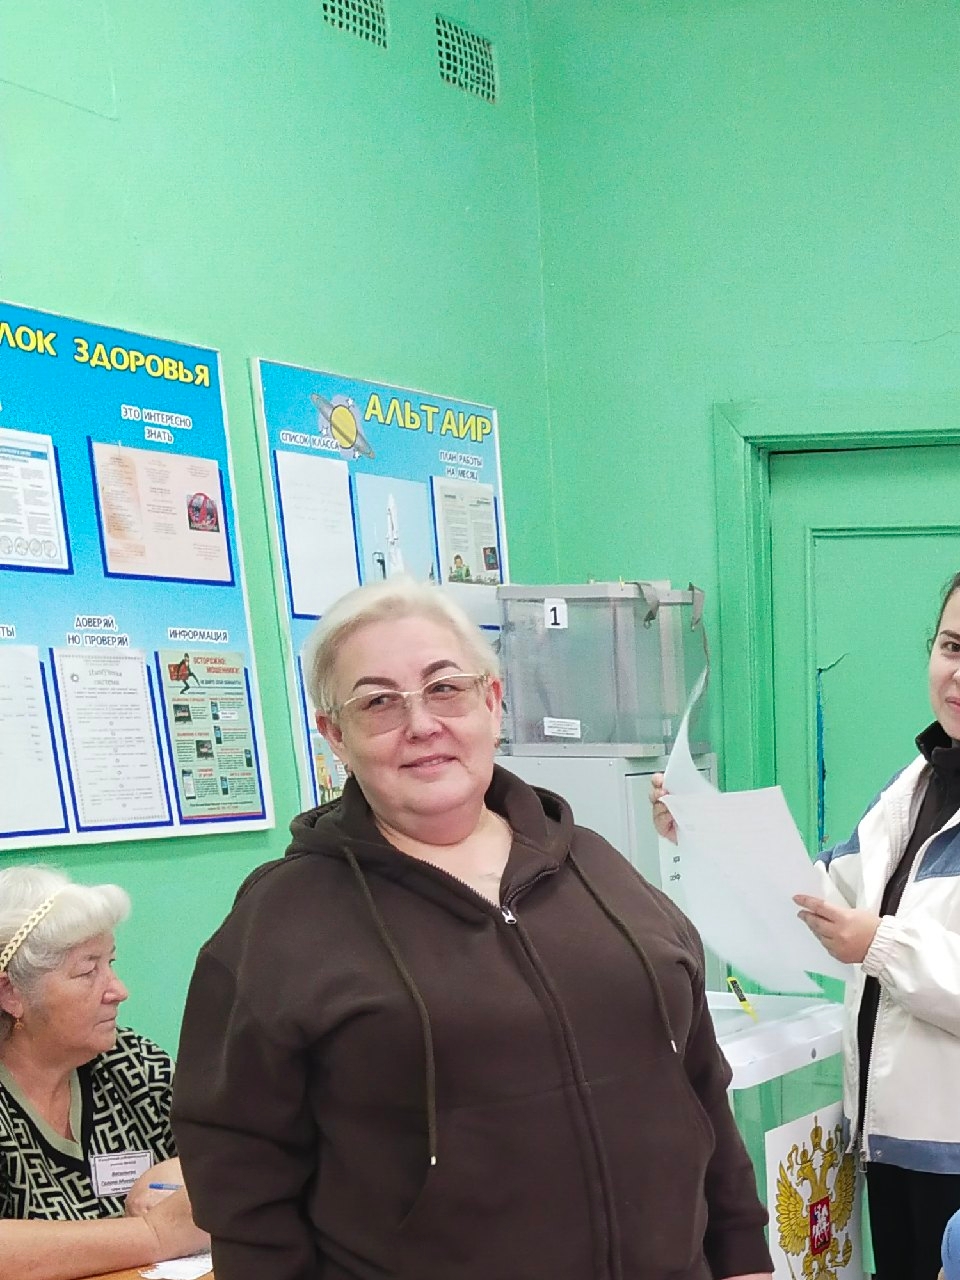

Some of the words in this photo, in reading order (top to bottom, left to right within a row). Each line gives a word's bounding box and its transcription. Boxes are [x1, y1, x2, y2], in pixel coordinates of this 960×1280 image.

[73, 336, 211, 388] ЗДОРОВЬЯ
[122, 406, 140, 419] ЭТО
[143, 411, 192, 428] ИНТЕРЕСНО
[364, 392, 492, 443] АЛЬТАИР
[145, 428, 173, 443] ЗНАТЬ
[282, 432, 309, 445] СПИСОК
[312, 437, 340, 450] КЛАССА
[440, 451, 457, 461] ПЛАН
[458, 455, 482, 466] РАБОТЫ
[446, 467, 454, 476] НА
[75, 616, 118, 630] ДОВЕРЯЙ,
[549, 606, 561, 626] 1
[67, 635, 81, 645] НО
[84, 635, 129, 646] ПРОВЕРЯЙ
[169, 629, 228, 644] ИНФОРМАЦИЯ
